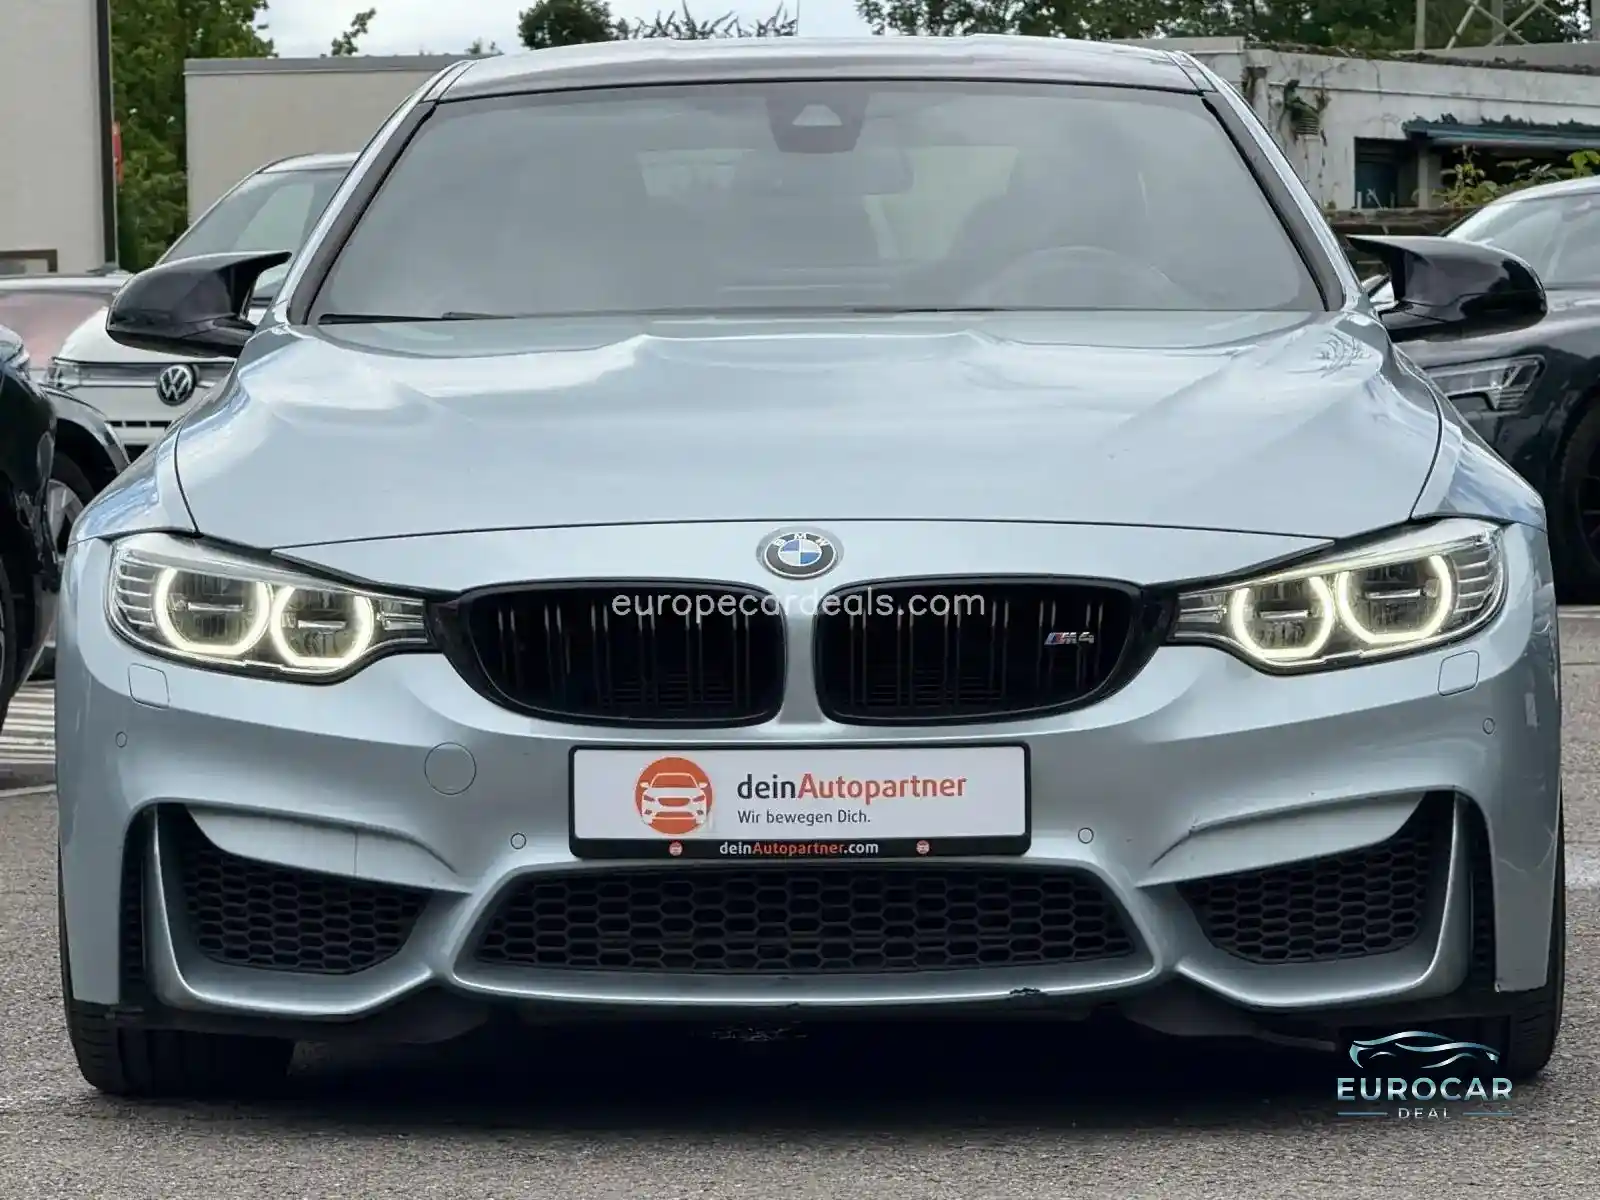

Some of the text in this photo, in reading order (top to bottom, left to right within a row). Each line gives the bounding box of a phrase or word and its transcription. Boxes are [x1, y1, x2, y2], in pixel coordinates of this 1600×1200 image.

[160, 366, 192, 401] VW
[737, 772, 968, 806] deinAutopartner
[737, 808, 871, 826] Wir bewegen Dich.
[719, 841, 879, 857] deinAutopartner.com
